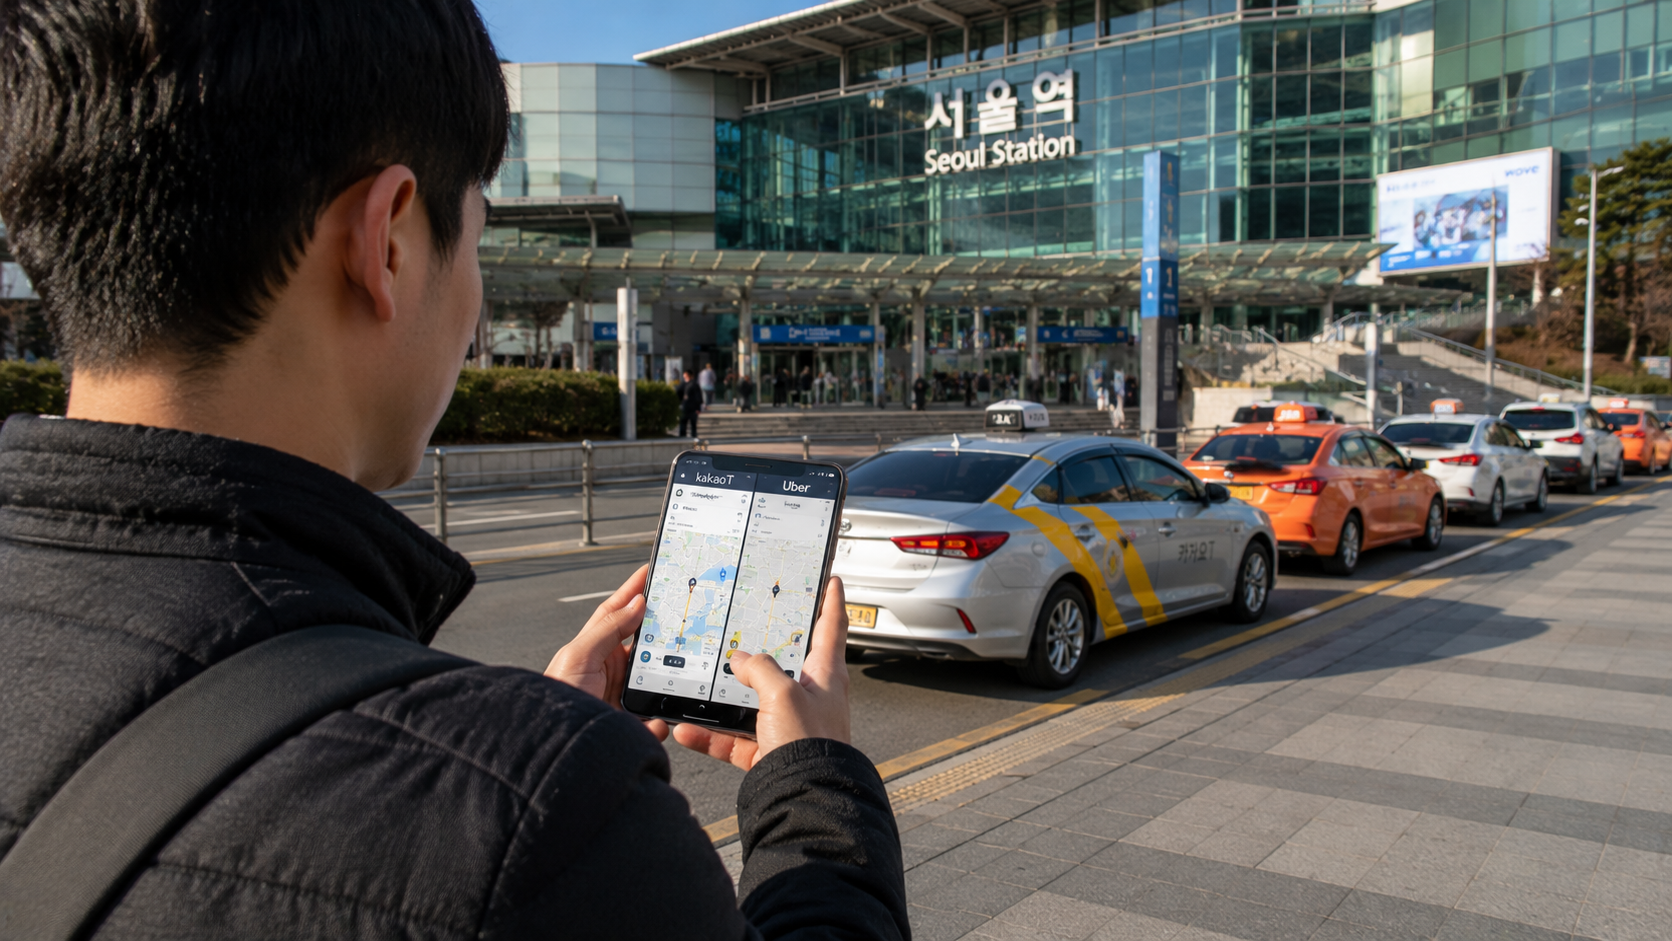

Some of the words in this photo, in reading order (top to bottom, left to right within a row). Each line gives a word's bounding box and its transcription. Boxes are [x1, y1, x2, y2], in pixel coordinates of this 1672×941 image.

[924, 69, 1074, 139] 서울역
[924, 141, 986, 175] Seoul
[992, 133, 1075, 164] Station
[782, 480, 811, 493] Uber
